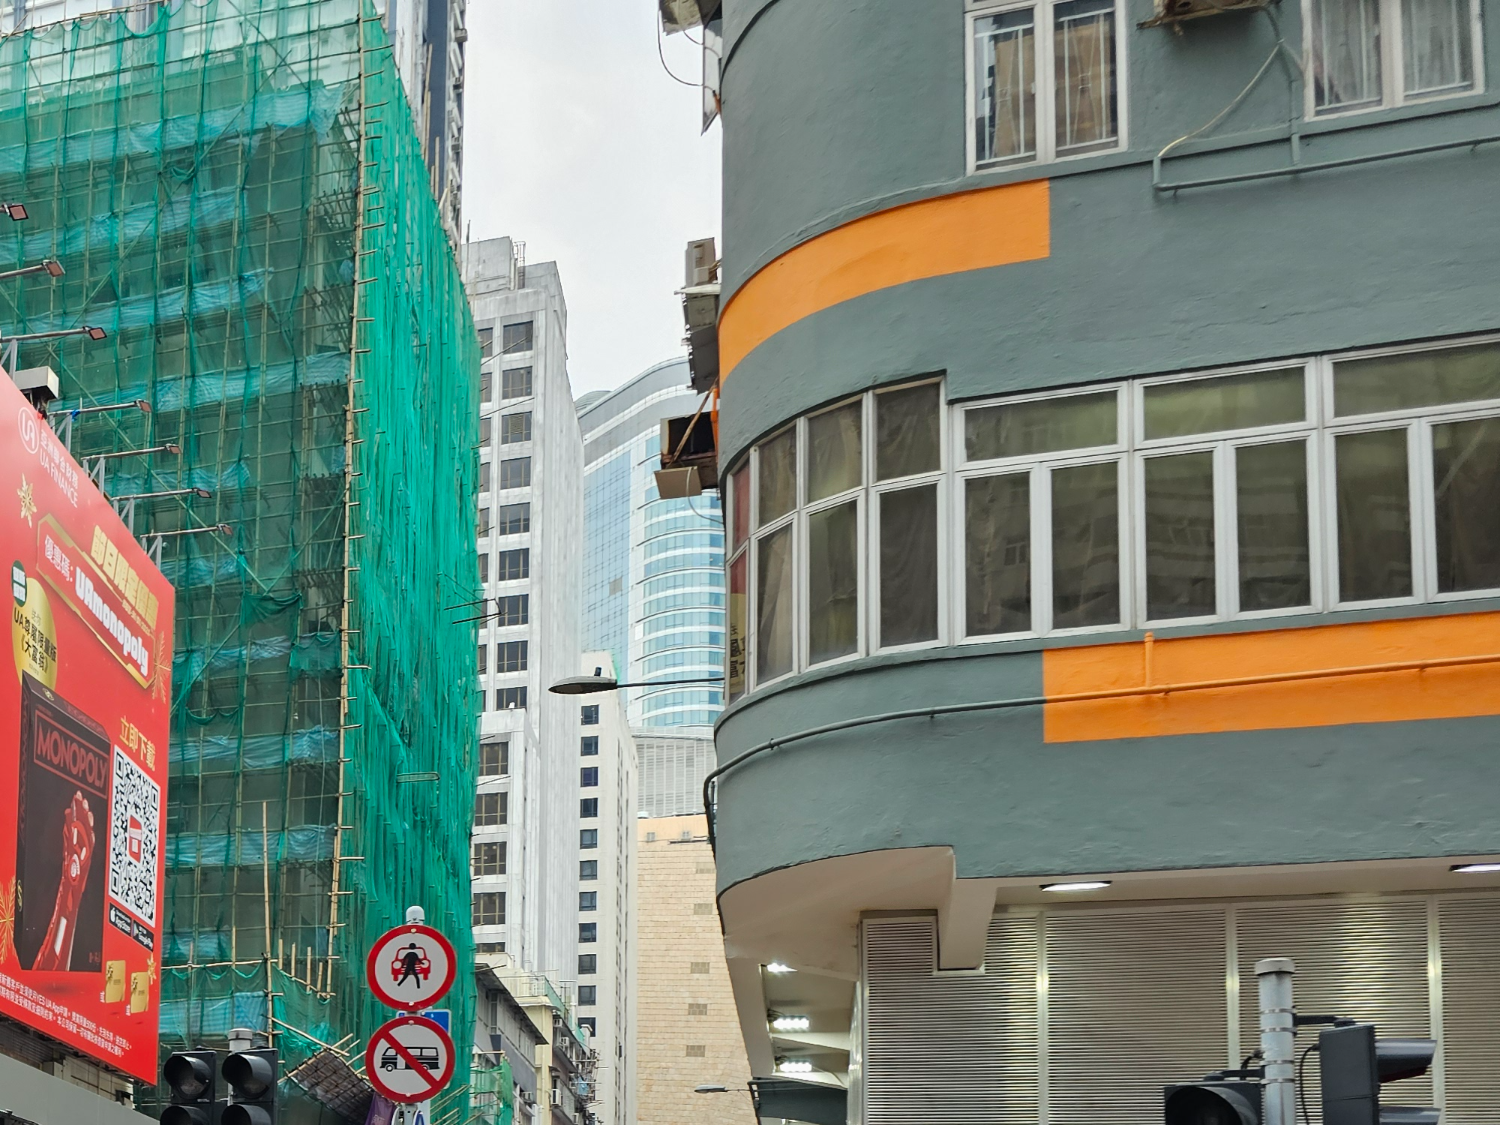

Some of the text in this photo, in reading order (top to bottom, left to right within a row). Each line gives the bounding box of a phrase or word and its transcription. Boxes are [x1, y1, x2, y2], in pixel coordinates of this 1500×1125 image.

[75, 566, 149, 678] UAmonopoly
[37, 721, 108, 789] MONOPOLY
[119, 715, 156, 772] 立即下載
